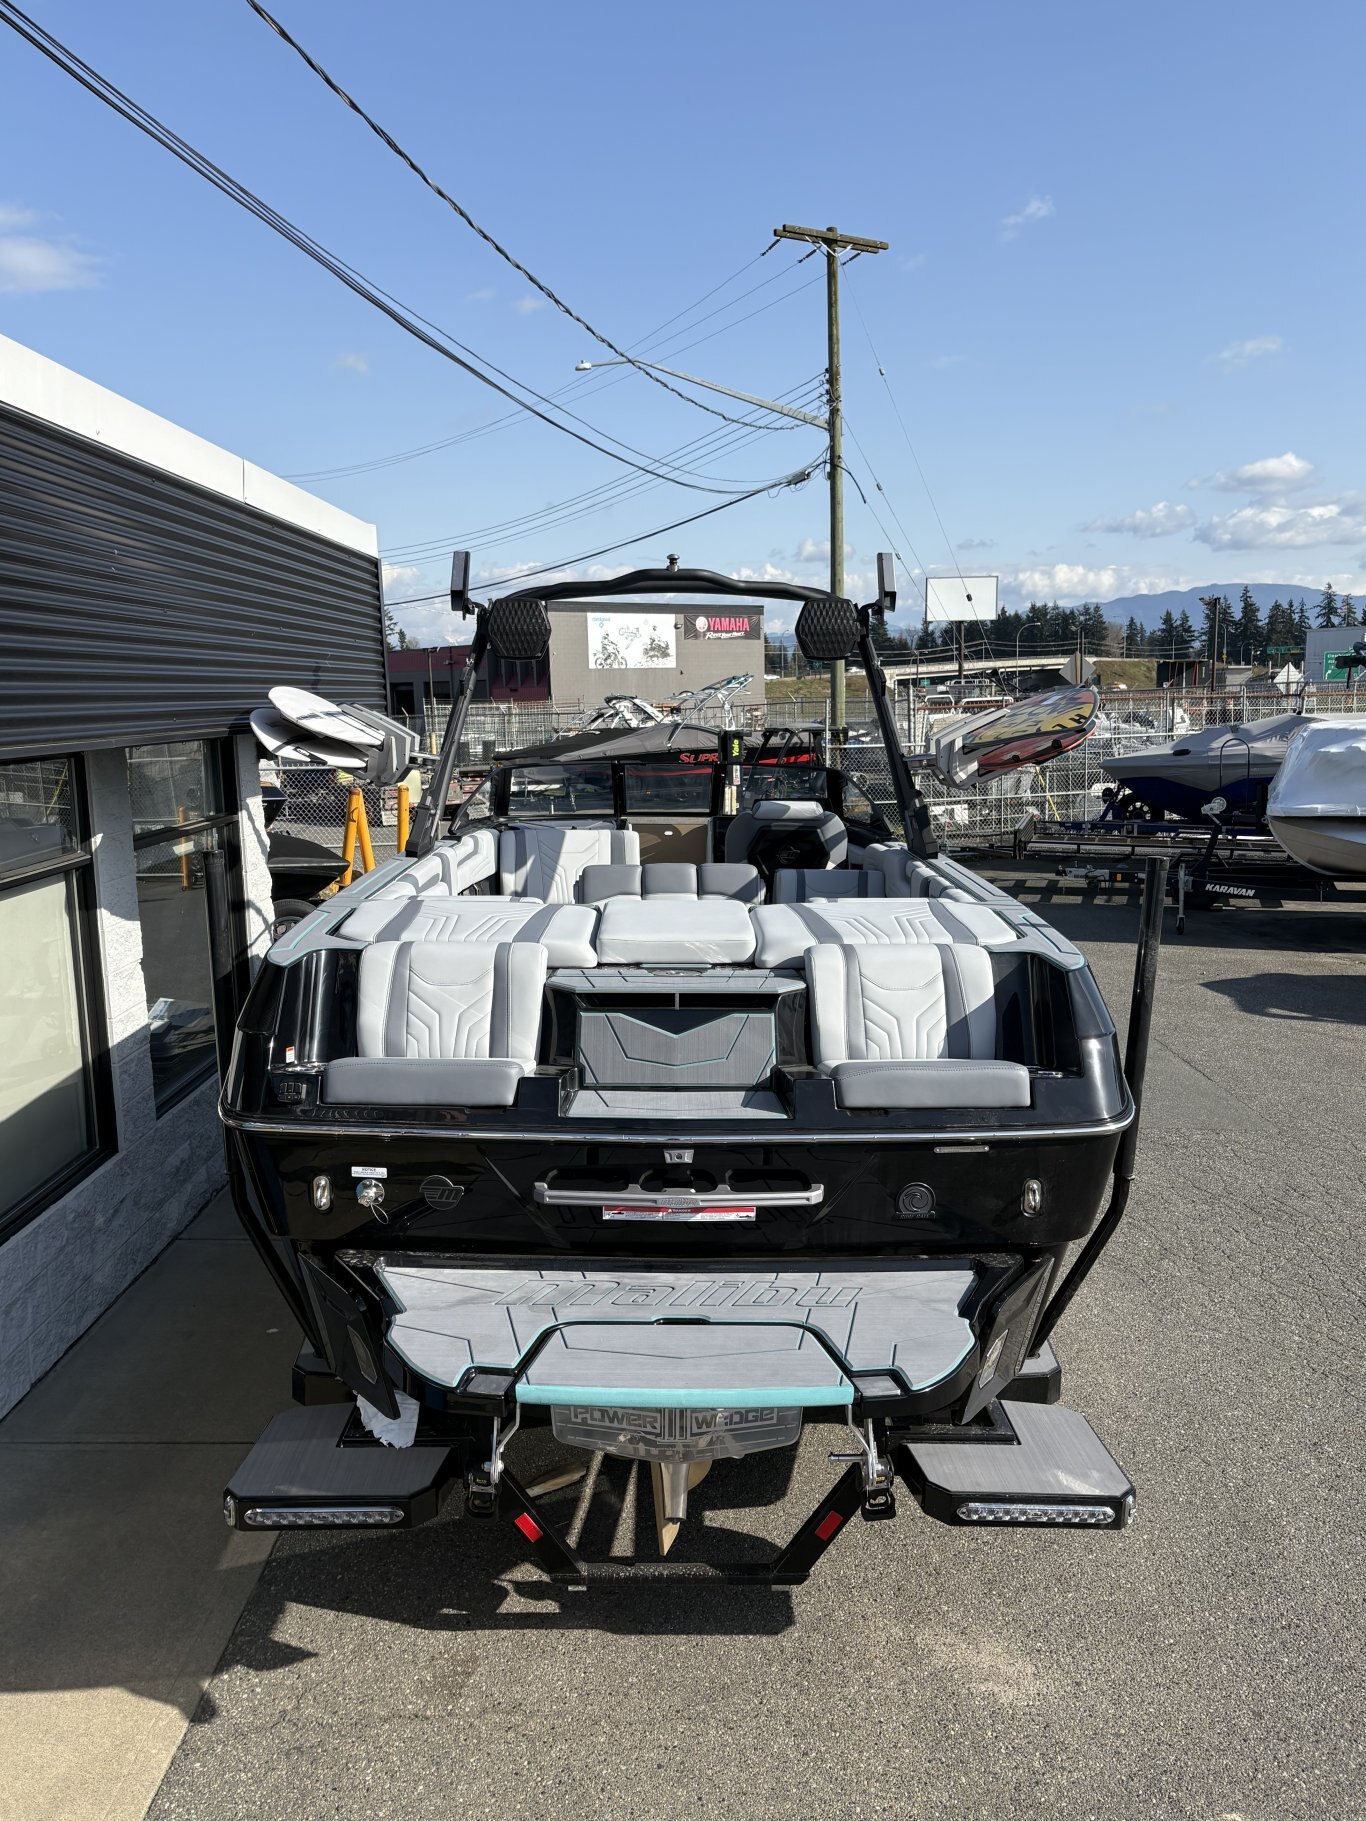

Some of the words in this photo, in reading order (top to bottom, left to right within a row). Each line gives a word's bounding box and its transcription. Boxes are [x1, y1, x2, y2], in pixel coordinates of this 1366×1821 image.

[708, 617, 750, 631] YAMAHA
[679, 752, 719, 763] SUPR
[1205, 883, 1256, 897] KARAVAN
[571, 1406, 659, 1430] POWER
